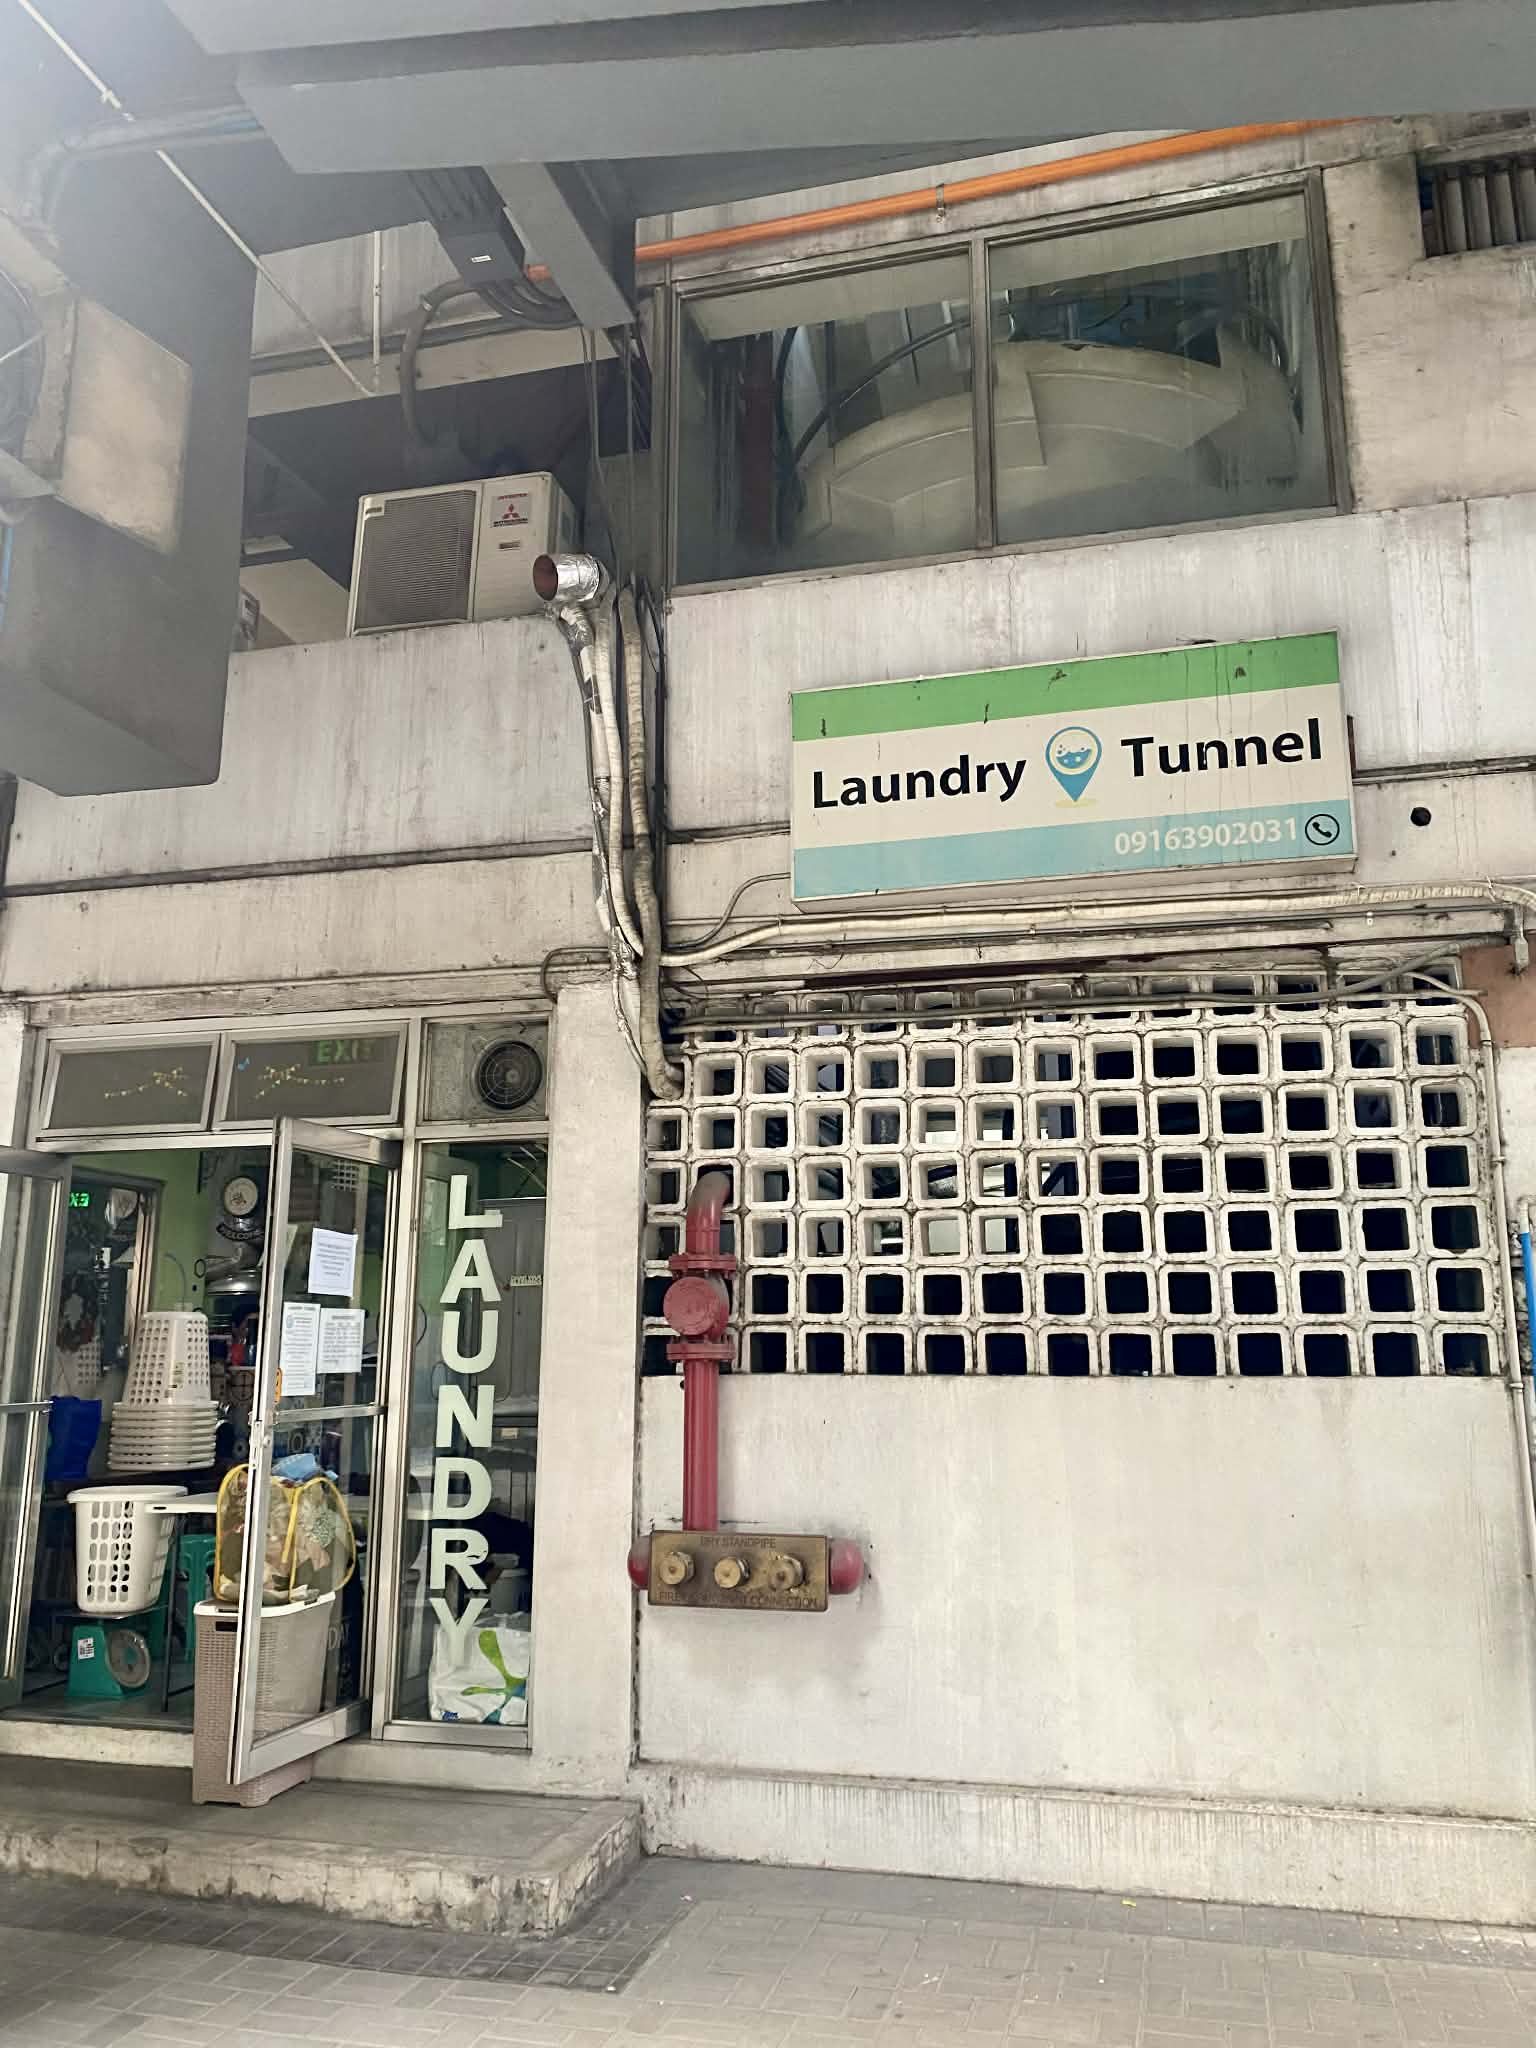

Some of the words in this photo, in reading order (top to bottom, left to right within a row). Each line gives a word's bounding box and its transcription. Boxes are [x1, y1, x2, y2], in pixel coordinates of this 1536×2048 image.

[813, 754, 1027, 809] Laundry
[1121, 717, 1322, 778] Tunnel
[1114, 816, 1298, 856] 09163902031
[429, 1174, 503, 1665] LAUNDRY
